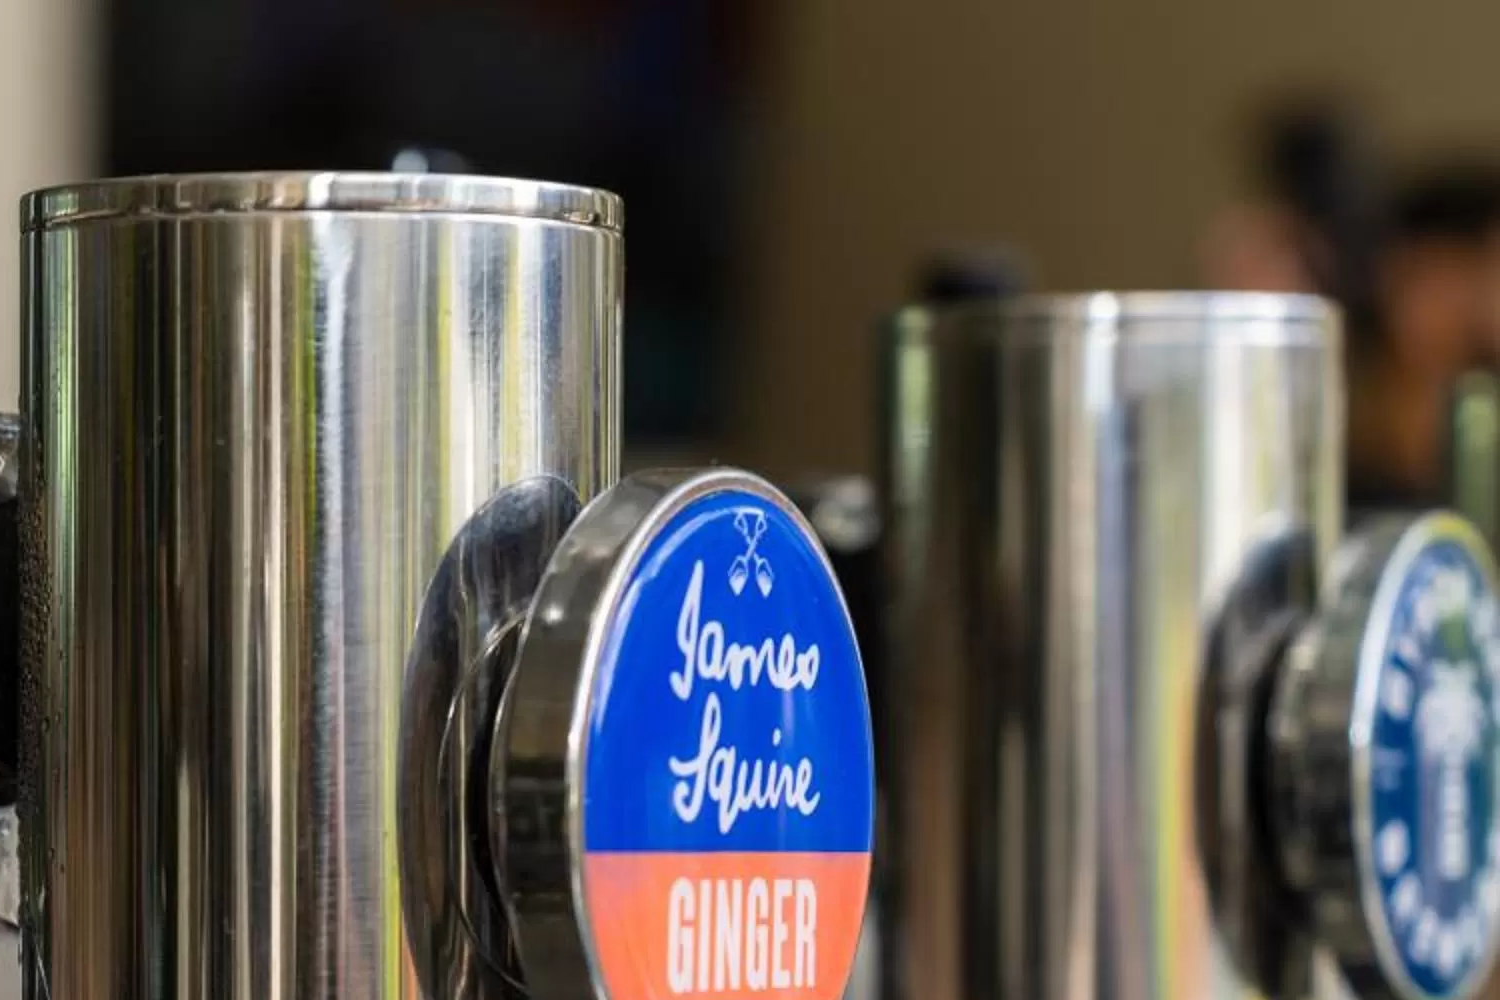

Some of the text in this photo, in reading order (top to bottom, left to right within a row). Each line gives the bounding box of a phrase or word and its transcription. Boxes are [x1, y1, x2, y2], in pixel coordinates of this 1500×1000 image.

[669, 559, 820, 701] James
[668, 691, 821, 835] Squire
[668, 876, 817, 994] GINGER
